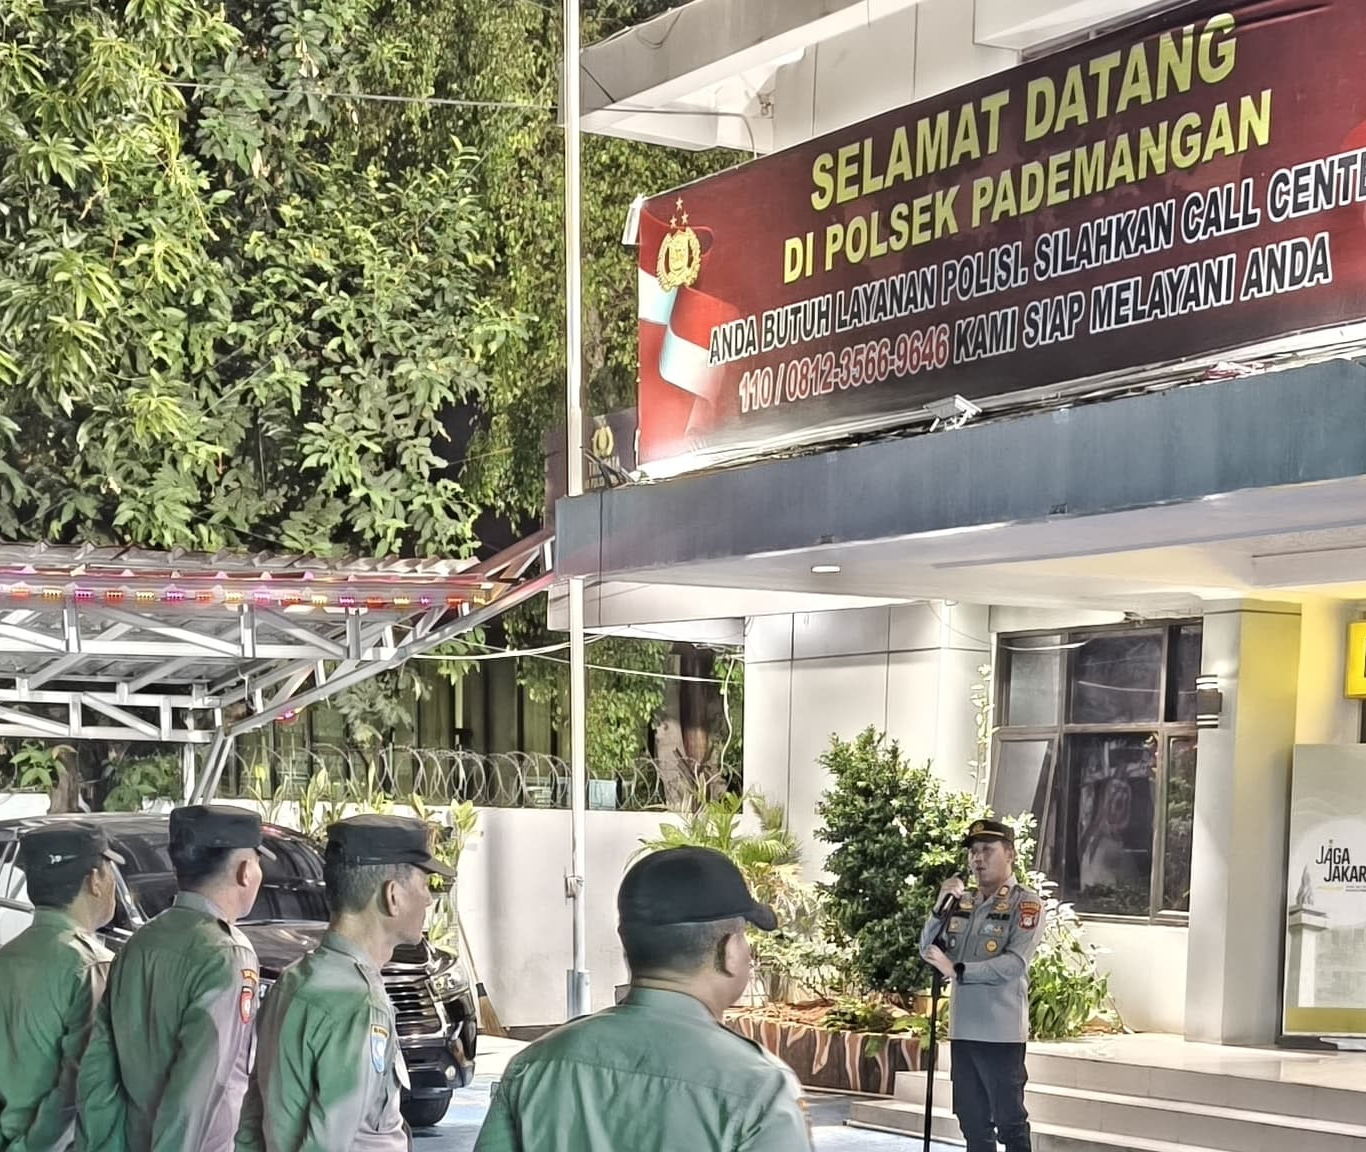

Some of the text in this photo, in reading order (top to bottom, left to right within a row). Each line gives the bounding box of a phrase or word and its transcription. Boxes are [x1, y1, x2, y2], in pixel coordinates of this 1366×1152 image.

[784, 89, 1273, 284] DI POLSEK PADEMANGAN
[811, 12, 1237, 211] SELAMAT DATANG
[707, 315, 758, 367] ANDA
[762, 294, 832, 352] BUTUH
[835, 264, 937, 332] LAYANAN
[941, 241, 1028, 305] POLISI.
[1034, 199, 1176, 282] SILAHKAN
[1181, 178, 1261, 244] CALL
[738, 366, 774, 413] 110
[785, 323, 950, 402] 0812-3566-9646
[953, 306, 1019, 364] KAMI
[1023, 291, 1085, 348] SIAP
[1089, 254, 1237, 334] MELAYANI
[1239, 232, 1333, 301] ANDA
[1315, 845, 1350, 865] JAGA
